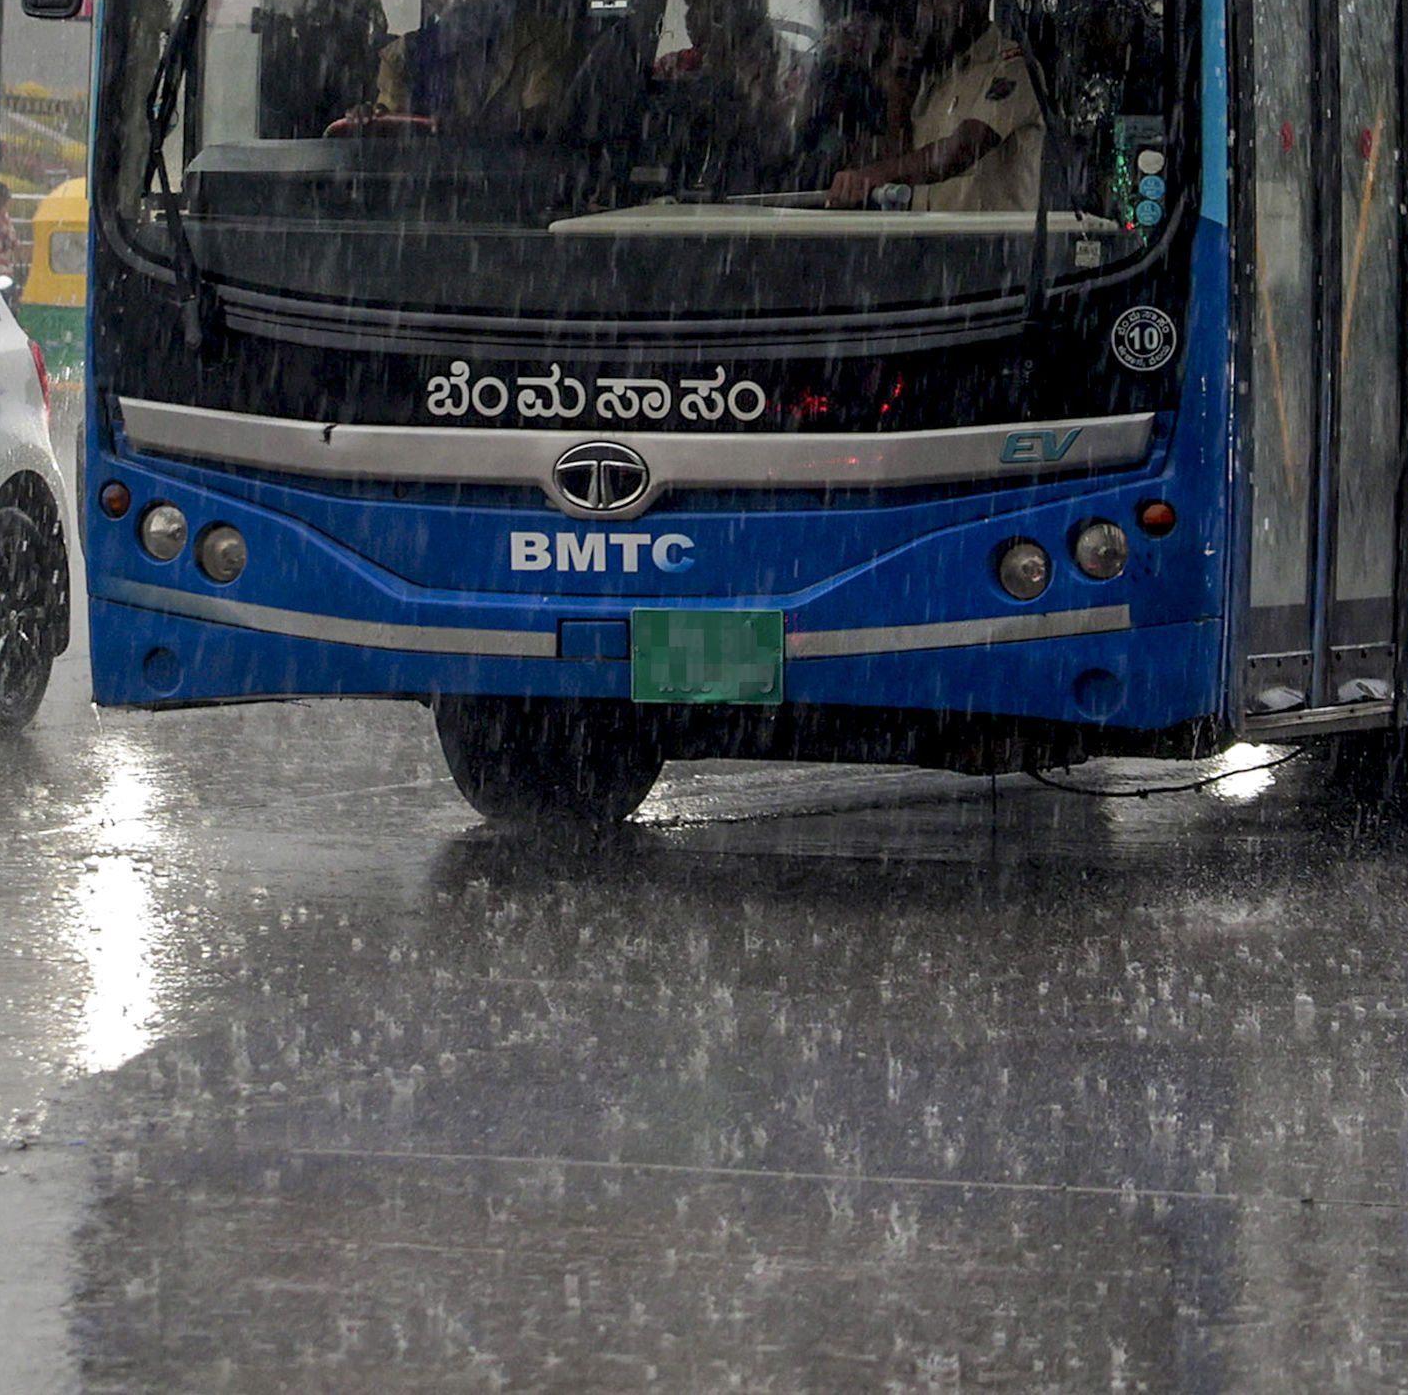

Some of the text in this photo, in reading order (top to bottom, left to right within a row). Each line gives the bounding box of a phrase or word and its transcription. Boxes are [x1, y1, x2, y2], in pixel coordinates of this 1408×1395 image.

[1129, 326, 1159, 351] 10
[1000, 427, 1083, 464] EV
[510, 531, 696, 574] BMTC
